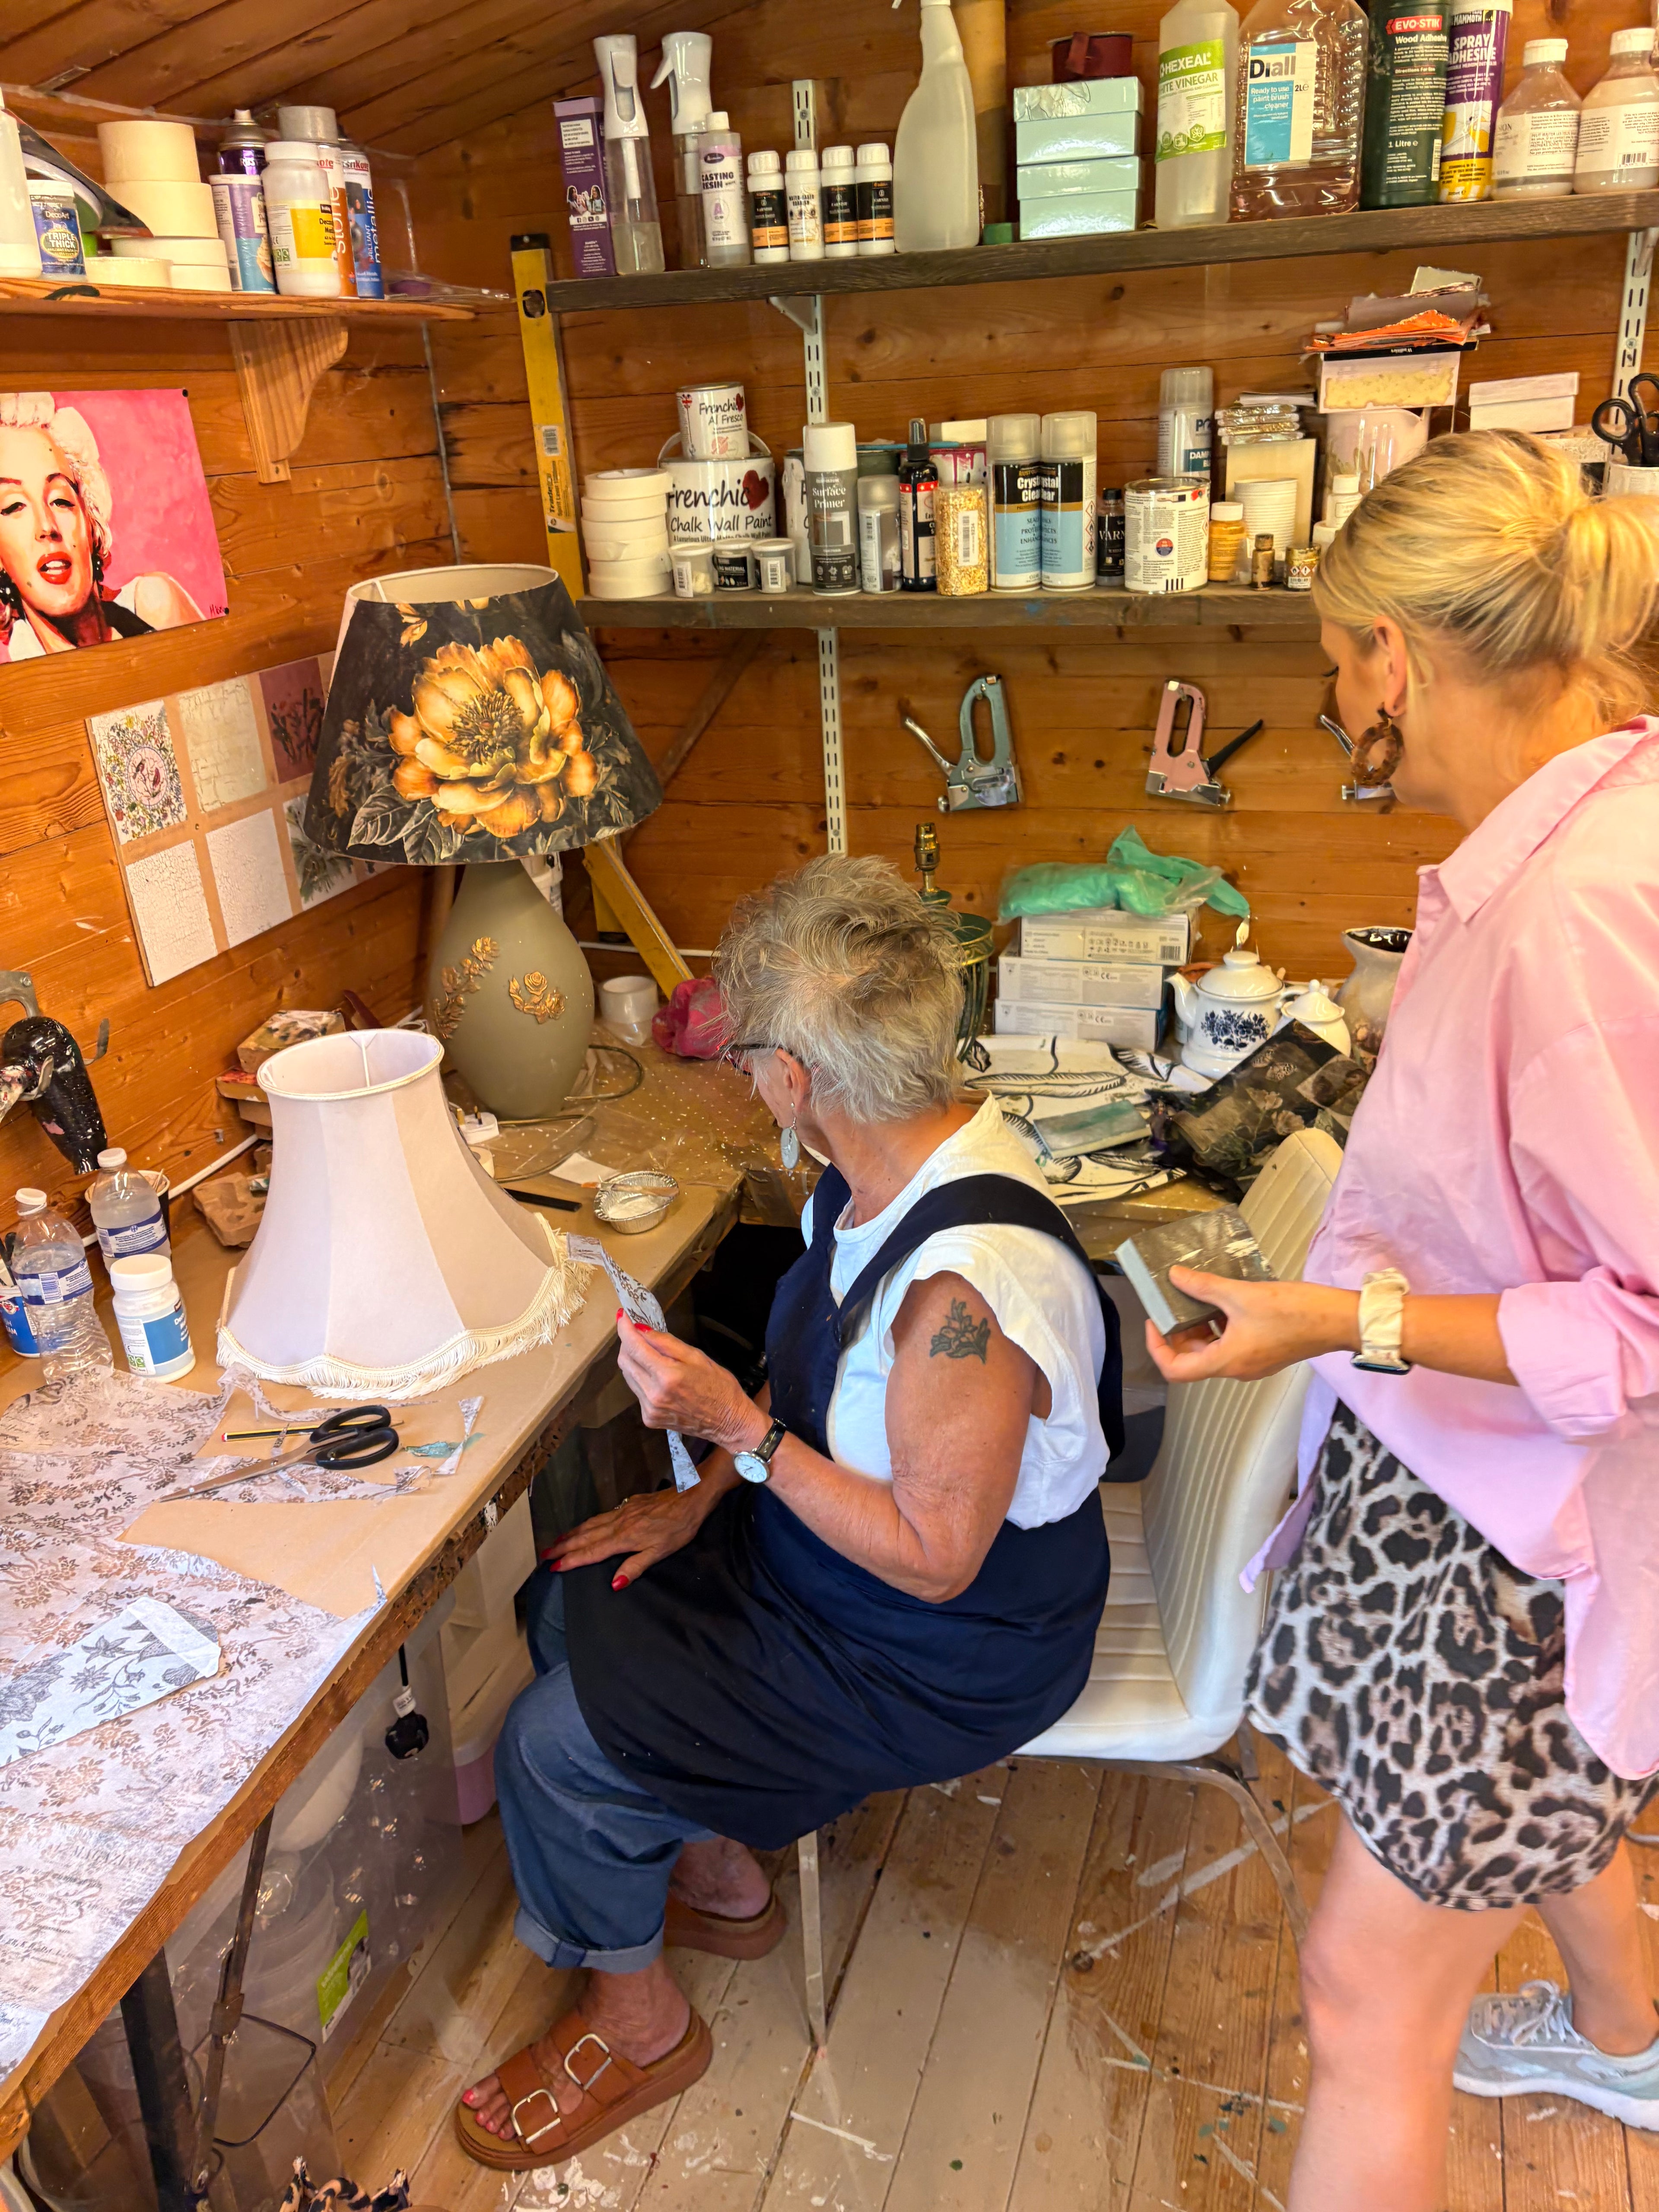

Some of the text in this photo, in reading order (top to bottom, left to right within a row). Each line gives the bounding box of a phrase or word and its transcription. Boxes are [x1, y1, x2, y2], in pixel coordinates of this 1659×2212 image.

[1453, 14, 1482, 25] MAMMOTH
[1395, 34, 1418, 44] Wood
[1453, 33, 1491, 51] SPRAY
[1165, 53, 1211, 75] HEXEAL
[1249, 55, 1296, 79] Diall
[1175, 71, 1219, 90] VINEGAR
[1251, 86, 1270, 95] Ready
[1253, 93, 1289, 104] paint brush
[702, 172, 734, 182] CASTING
[702, 181, 723, 190] RESIN
[45, 210, 70, 219] DecoArt
[47, 232, 76, 241] TRIPLE
[49, 240, 75, 249] THICK
[721, 413, 743, 424] Fresco
[812, 486, 847, 497] Surface
[814, 498, 845, 509] Primer
[671, 512, 772, 533] Chalk Wall Paint
